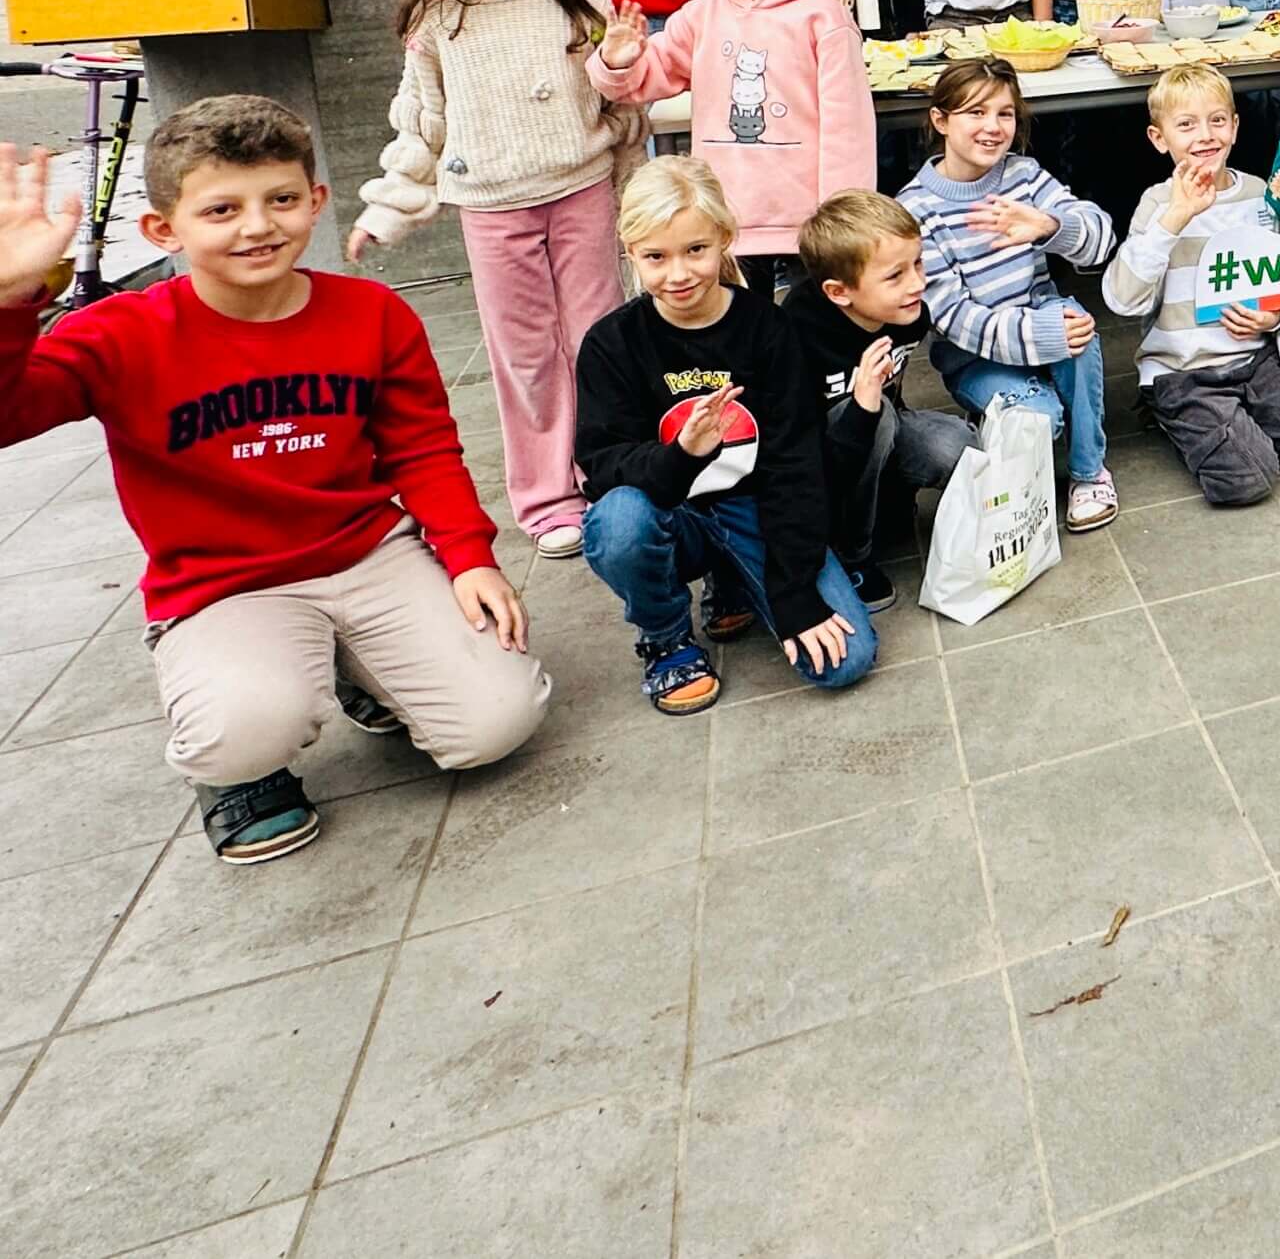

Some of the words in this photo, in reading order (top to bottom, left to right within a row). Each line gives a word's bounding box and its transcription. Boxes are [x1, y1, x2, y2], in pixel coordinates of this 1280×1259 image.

[93, 136, 124, 224] HEAD
[168, 373, 378, 454] BROOKLYN
[232, 441, 267, 460] NEW
[275, 433, 328, 454] YORK
